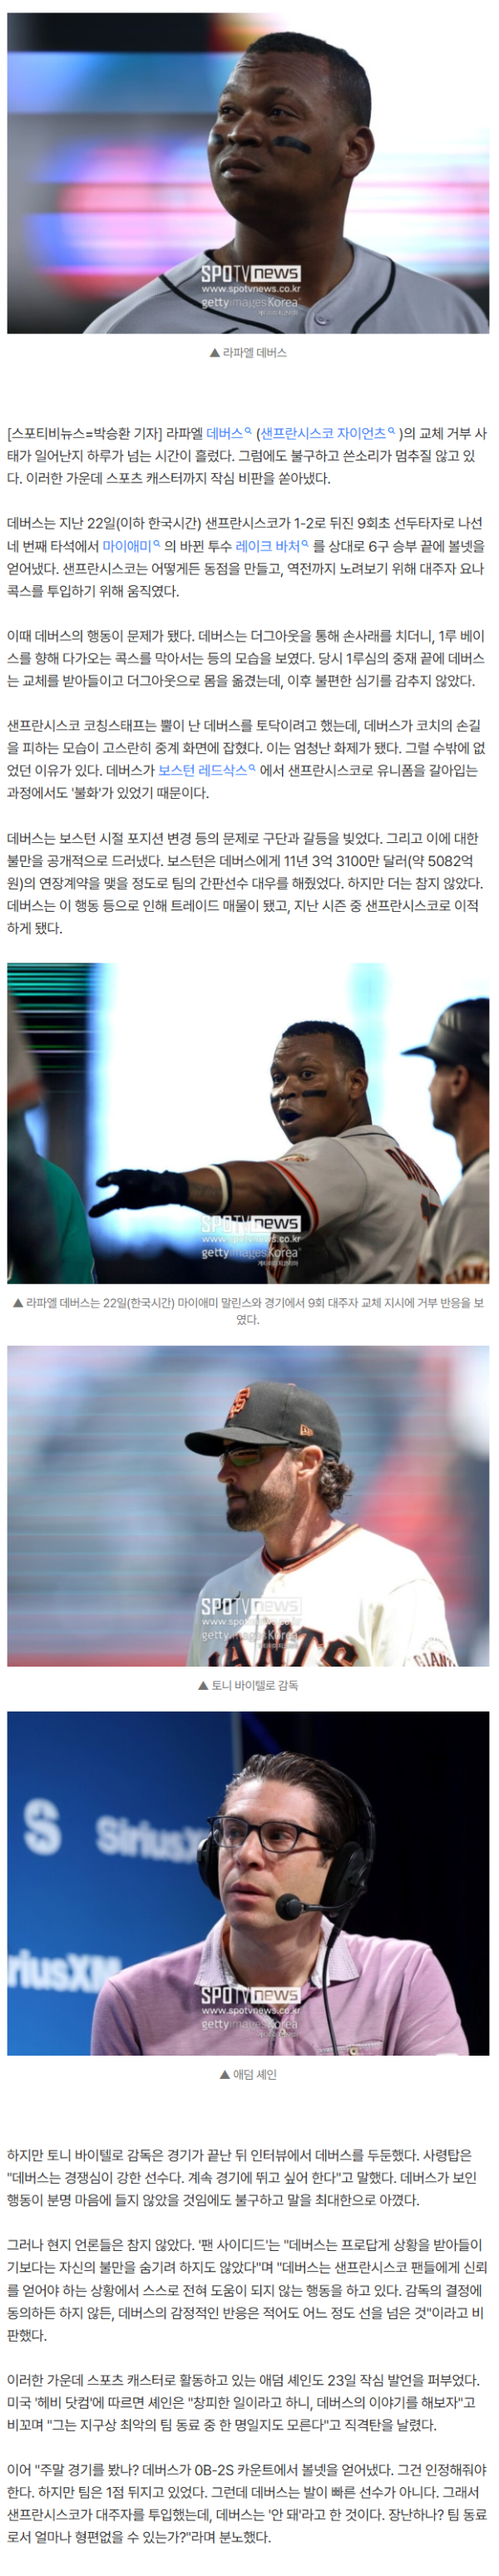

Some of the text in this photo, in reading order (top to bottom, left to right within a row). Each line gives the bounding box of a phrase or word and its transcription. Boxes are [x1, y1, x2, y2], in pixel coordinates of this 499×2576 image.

[224, 347, 287, 358] 라파엘 데버스
[7, 450, 475, 462] 태가 일어난지 하루가 넘는 시간이 흘렀다. 그럼에도 불구하고 쓴소리가 멈추질 않고 있
[7, 517, 482, 531] 데버스는 지난 22일(이하 한국시간) 샌프란시스코가 1-2로 뒤진 9회초 선두타자로 나선
[7, 630, 484, 644] 이때 데버스의 행동이 문제가 됐다. 데버스는 더그아웃을 통해 손사래를 치더니, 1루 베이
[7, 719, 480, 734] 샌프란시스코 코칭스태프는 뿔이 난 데버스를 토닥이려고 했는데, 데버스가 코치의 손길
[7, 855, 472, 869] 불만을 공개적으로 드러냈다. 보스턴은 데버스에게 11년 3억 3100만 달러(약 5082억
[7, 922, 62, 934] 하게 됐다.
[27, 1298, 484, 1310] 라파엘 데버스는 22일(한국시간) 마이애미 말린스와 경기에서 9회 대주자 교체 지시에 거부 반응을 보
[236, 1314, 259, 1325] 였다.
[212, 1680, 299, 1691] 토니 바이텔로 감독
[234, 2069, 276, 2080] 애덤 셰인
[7, 2149, 472, 2162] 하지만 토니 바이텔로 감독은 경기가 끝난 뒤 인터뷰에서 데버스를 두둔했다. 사령탑은
[7, 2239, 482, 2252] 그러나 현지 언론들은 참지 않았다. '팬 사이디드'는 "데버스는 프로답게 상황을 받아들이
[7, 2329, 47, 2342] 판했다.
[7, 2374, 480, 2386] 이러한 가운데 스포츠 캐스터로 활동하고 있는 애덤 셰인도 23일 작심 발언을 퍼부었다.
[7, 2464, 487, 2476] 이어 "주말 경기를 봤나? 데버스가 0B-2S 카운트에서 볼넷을 얻어냈다. 그건 인정해줘야
[7, 2531, 271, 2544] 로서 얼마나 형편없을 수 있는가?"라며 분노했다.
